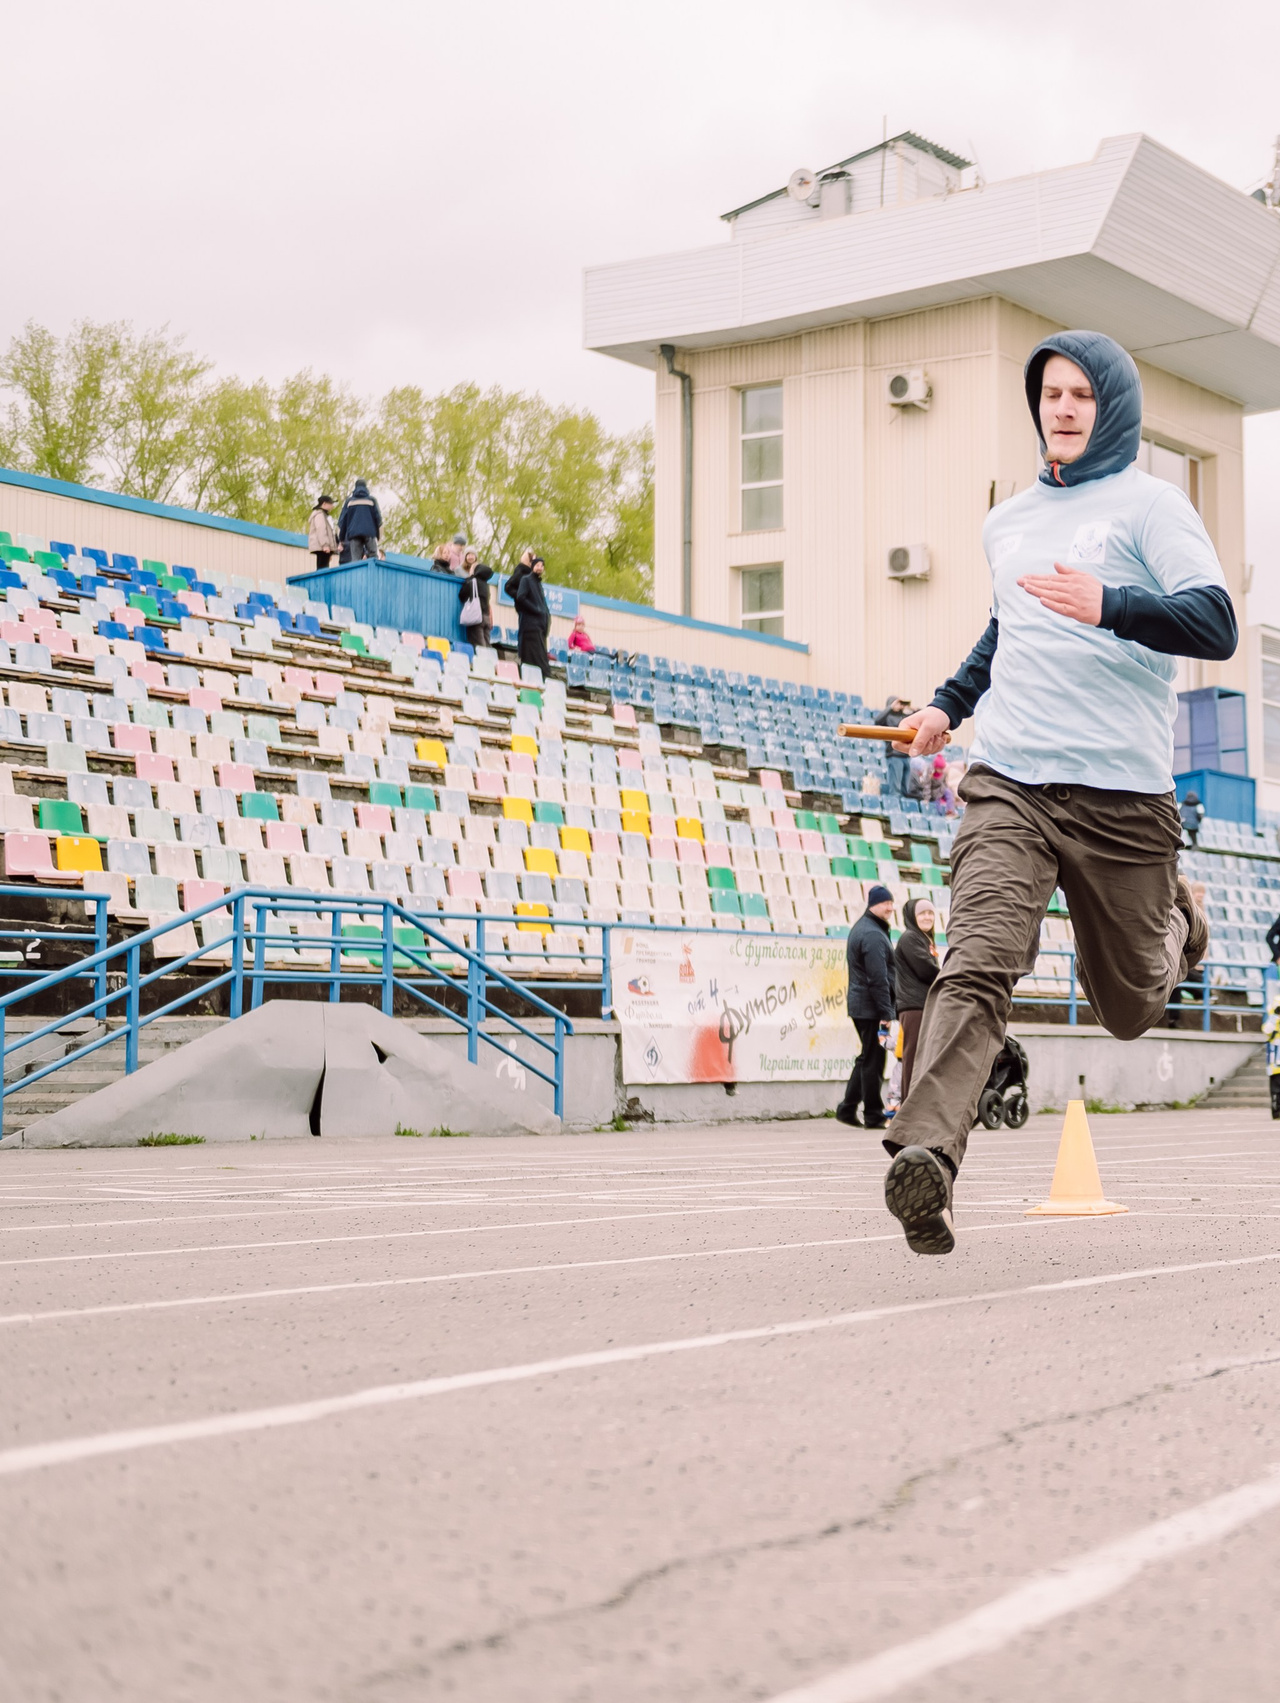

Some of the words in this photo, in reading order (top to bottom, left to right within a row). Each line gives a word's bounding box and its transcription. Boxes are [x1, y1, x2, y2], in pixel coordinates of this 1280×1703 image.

[745, 940, 807, 967] футболом
[809, 948, 823, 969] за
[719, 980, 797, 1065] Футбол
[780, 1018, 798, 1041] для
[760, 1053, 804, 1079] Играйте
[807, 1060, 820, 1071] на
